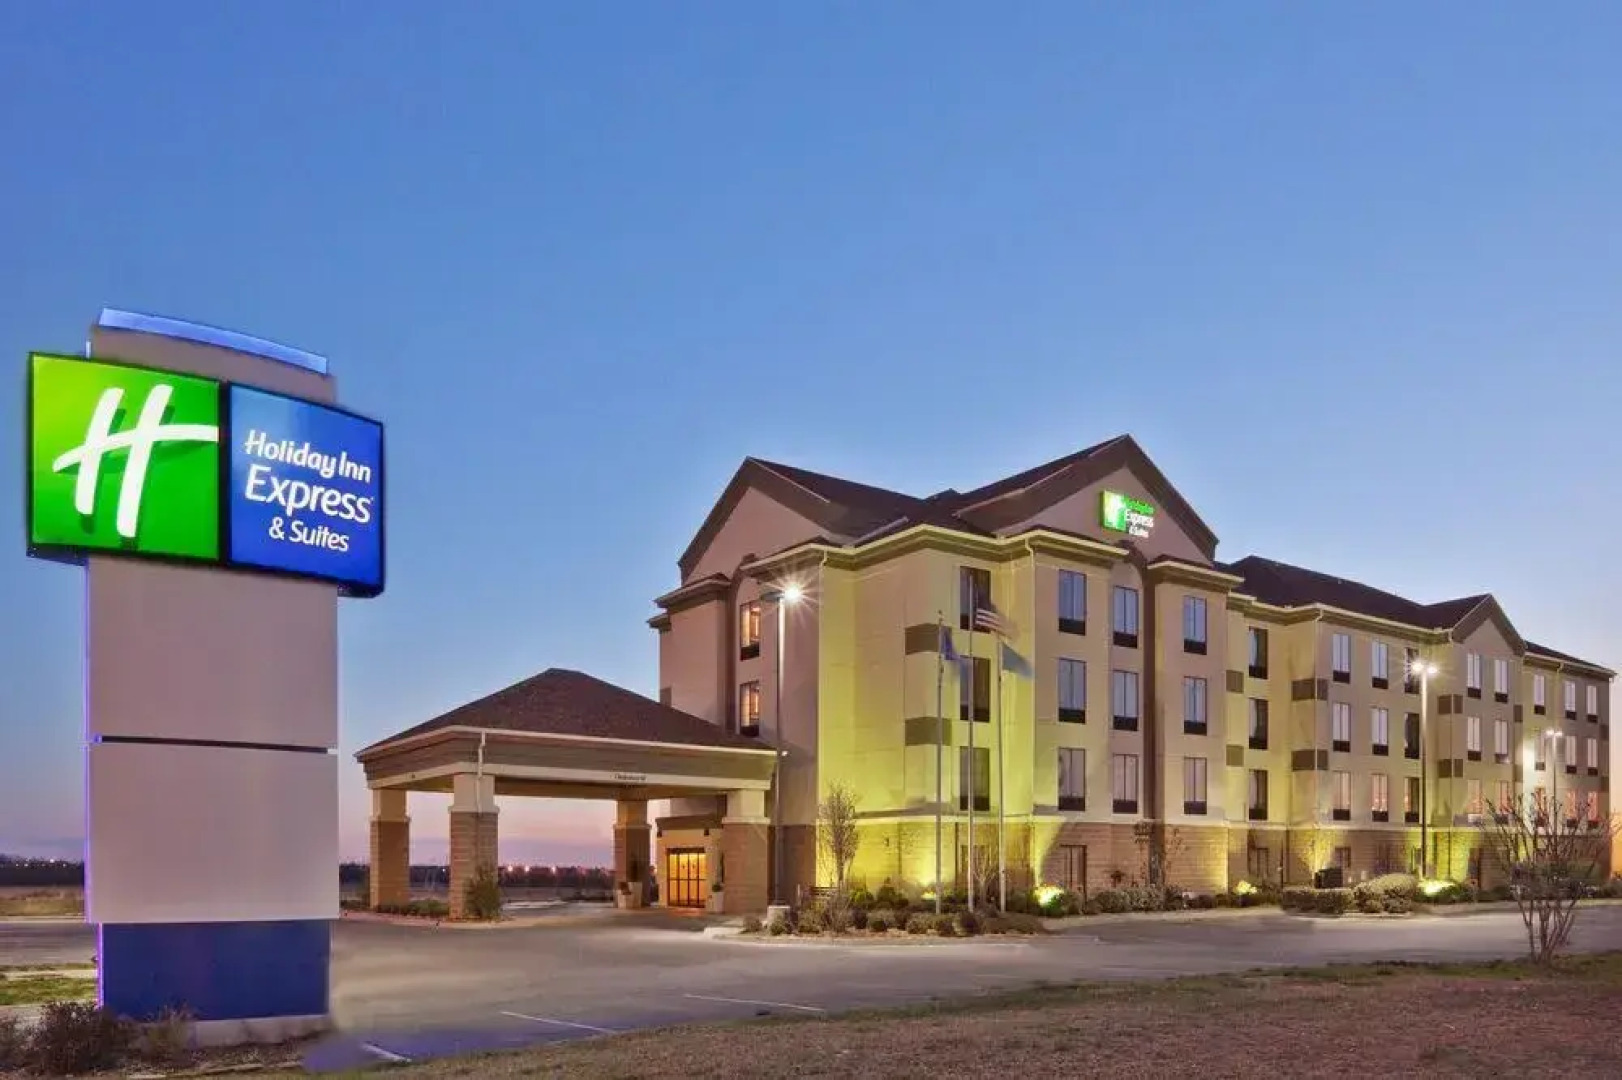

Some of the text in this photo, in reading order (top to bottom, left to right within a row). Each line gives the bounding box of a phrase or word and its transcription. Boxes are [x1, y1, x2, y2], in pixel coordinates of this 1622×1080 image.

[244, 430, 371, 482] Holiday Inn
[244, 465, 372, 523] Express
[268, 517, 349, 552] & Suites
